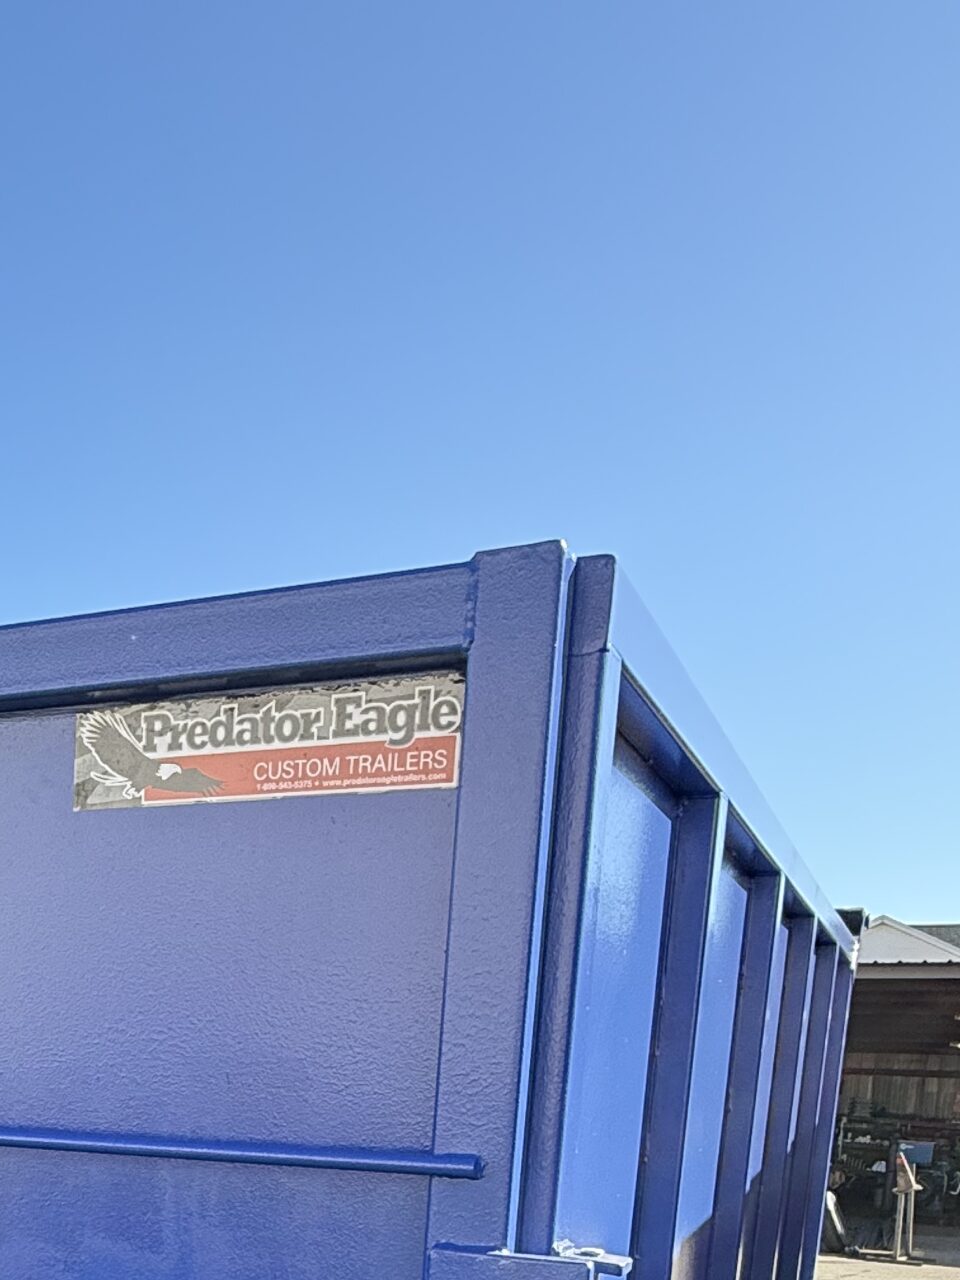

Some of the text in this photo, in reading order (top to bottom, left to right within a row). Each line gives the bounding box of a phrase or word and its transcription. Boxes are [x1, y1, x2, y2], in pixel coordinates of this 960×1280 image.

[142, 685, 462, 754] Predator Eagle
[253, 749, 448, 781] CUSTOM TRAILERS
